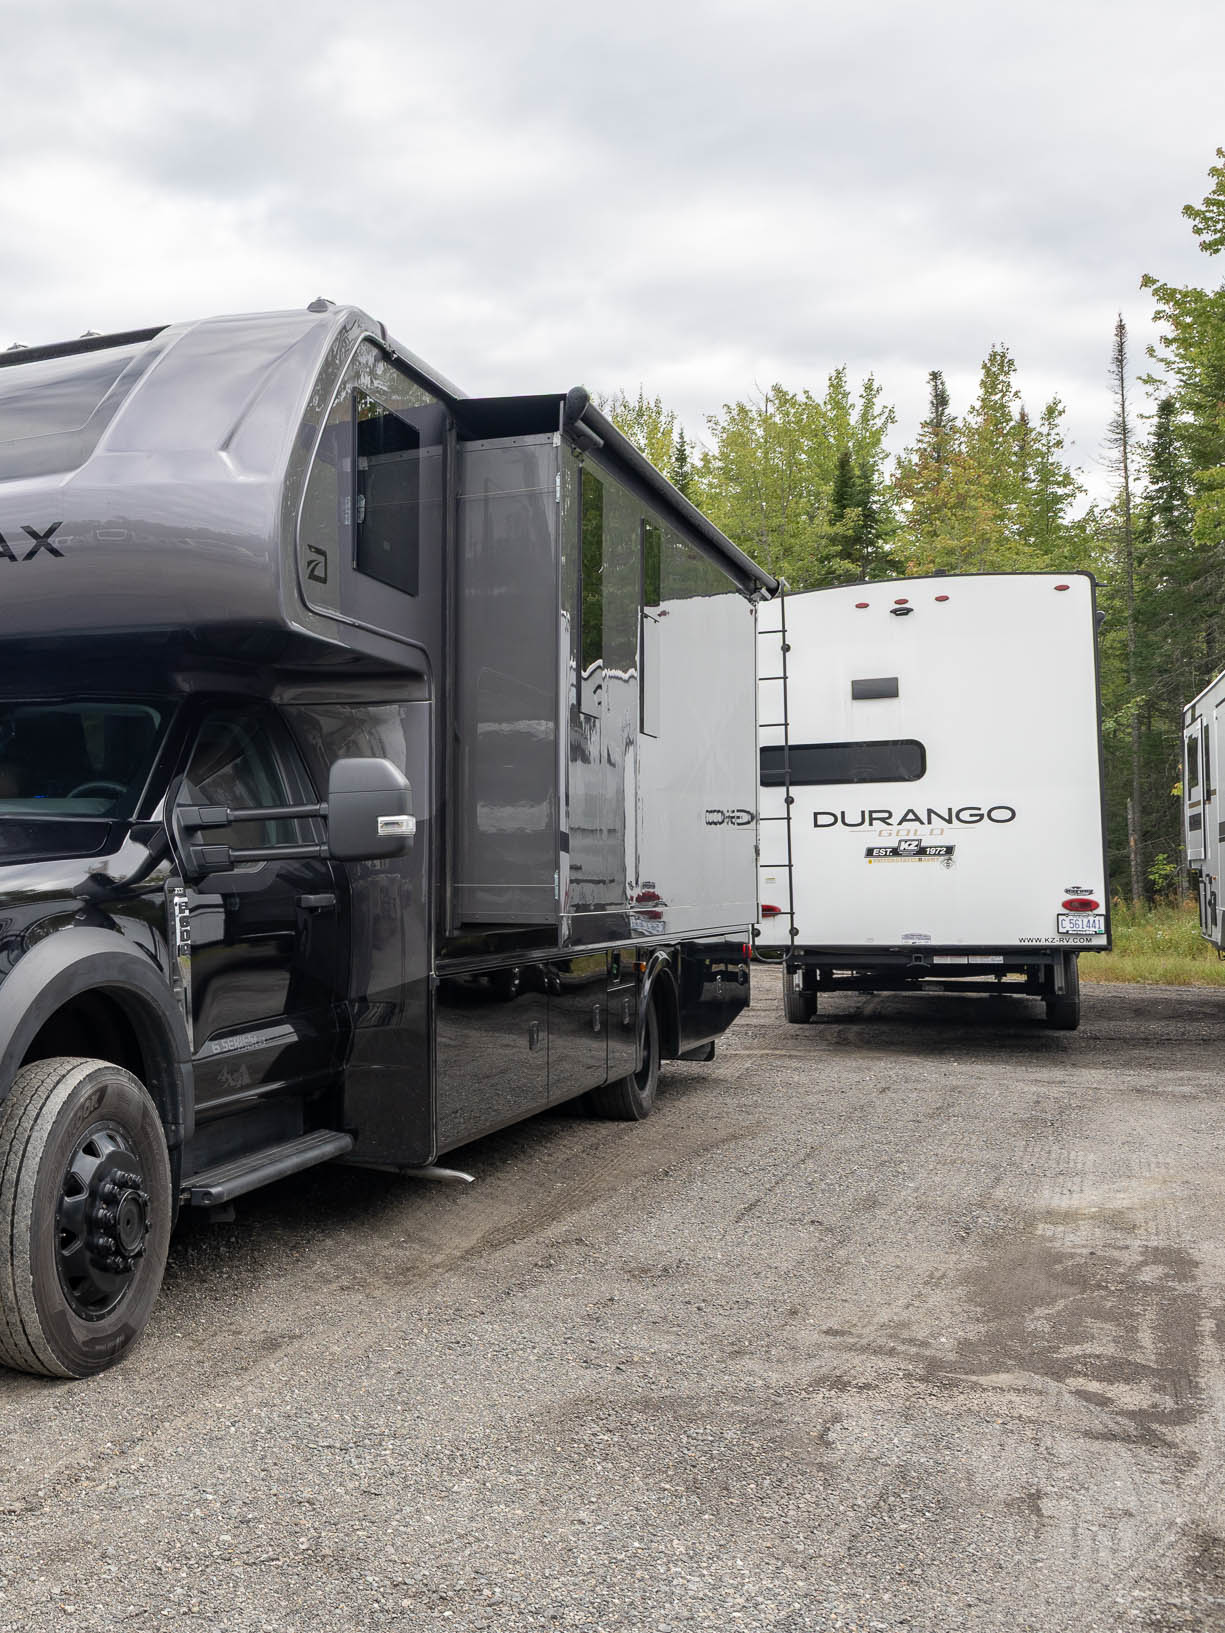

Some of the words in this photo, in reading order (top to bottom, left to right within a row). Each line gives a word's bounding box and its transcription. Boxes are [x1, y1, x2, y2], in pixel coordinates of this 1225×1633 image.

[813, 805, 1017, 828] DURANGO
[877, 828, 945, 838] GOLD
[899, 841, 919, 850] KZ
[872, 848, 893, 856] EST.
[925, 847, 947, 855] 1972
